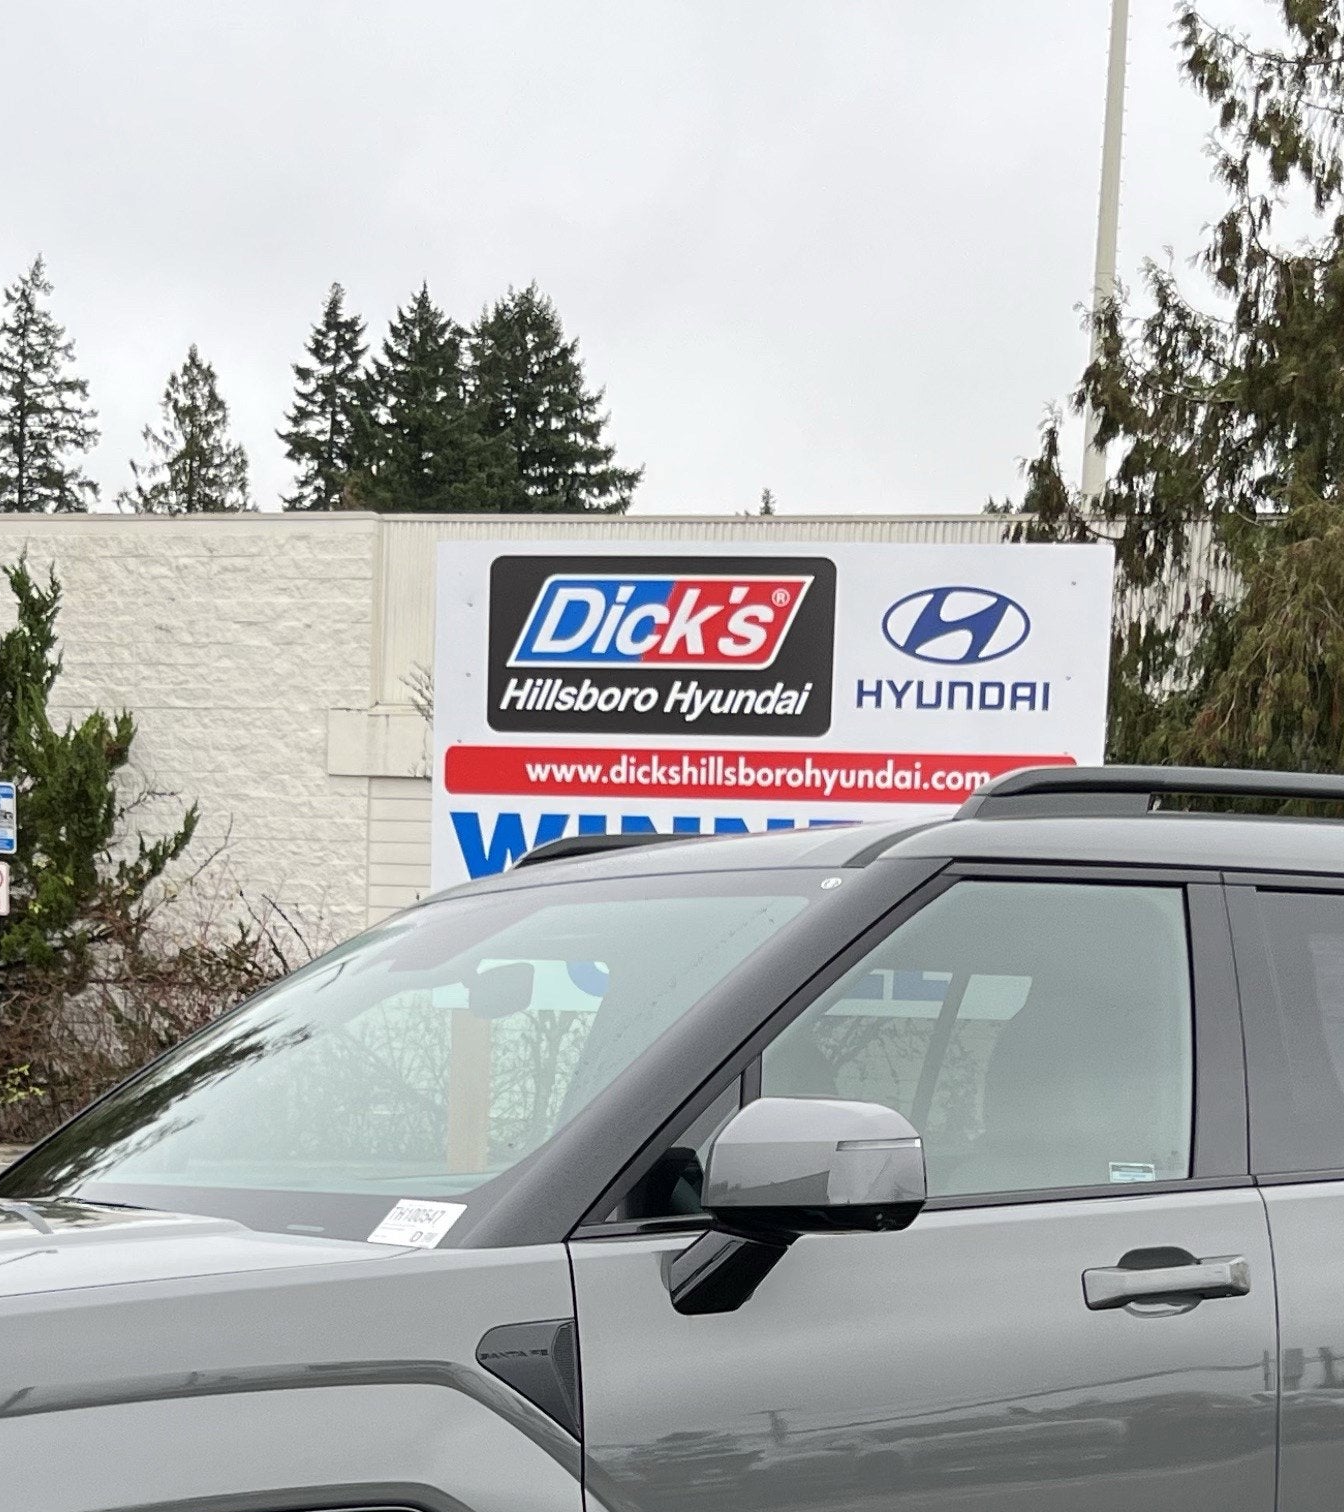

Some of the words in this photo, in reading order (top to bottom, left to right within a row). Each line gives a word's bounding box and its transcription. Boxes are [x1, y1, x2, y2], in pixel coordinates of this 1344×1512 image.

[531, 583, 777, 657] Dick's
[500, 678, 657, 713] Hillsboro
[663, 681, 812, 722] Hyundai
[855, 679, 1051, 712] HYUNDAI
[525, 754, 991, 796] www.dickshillsborohyundai.com
